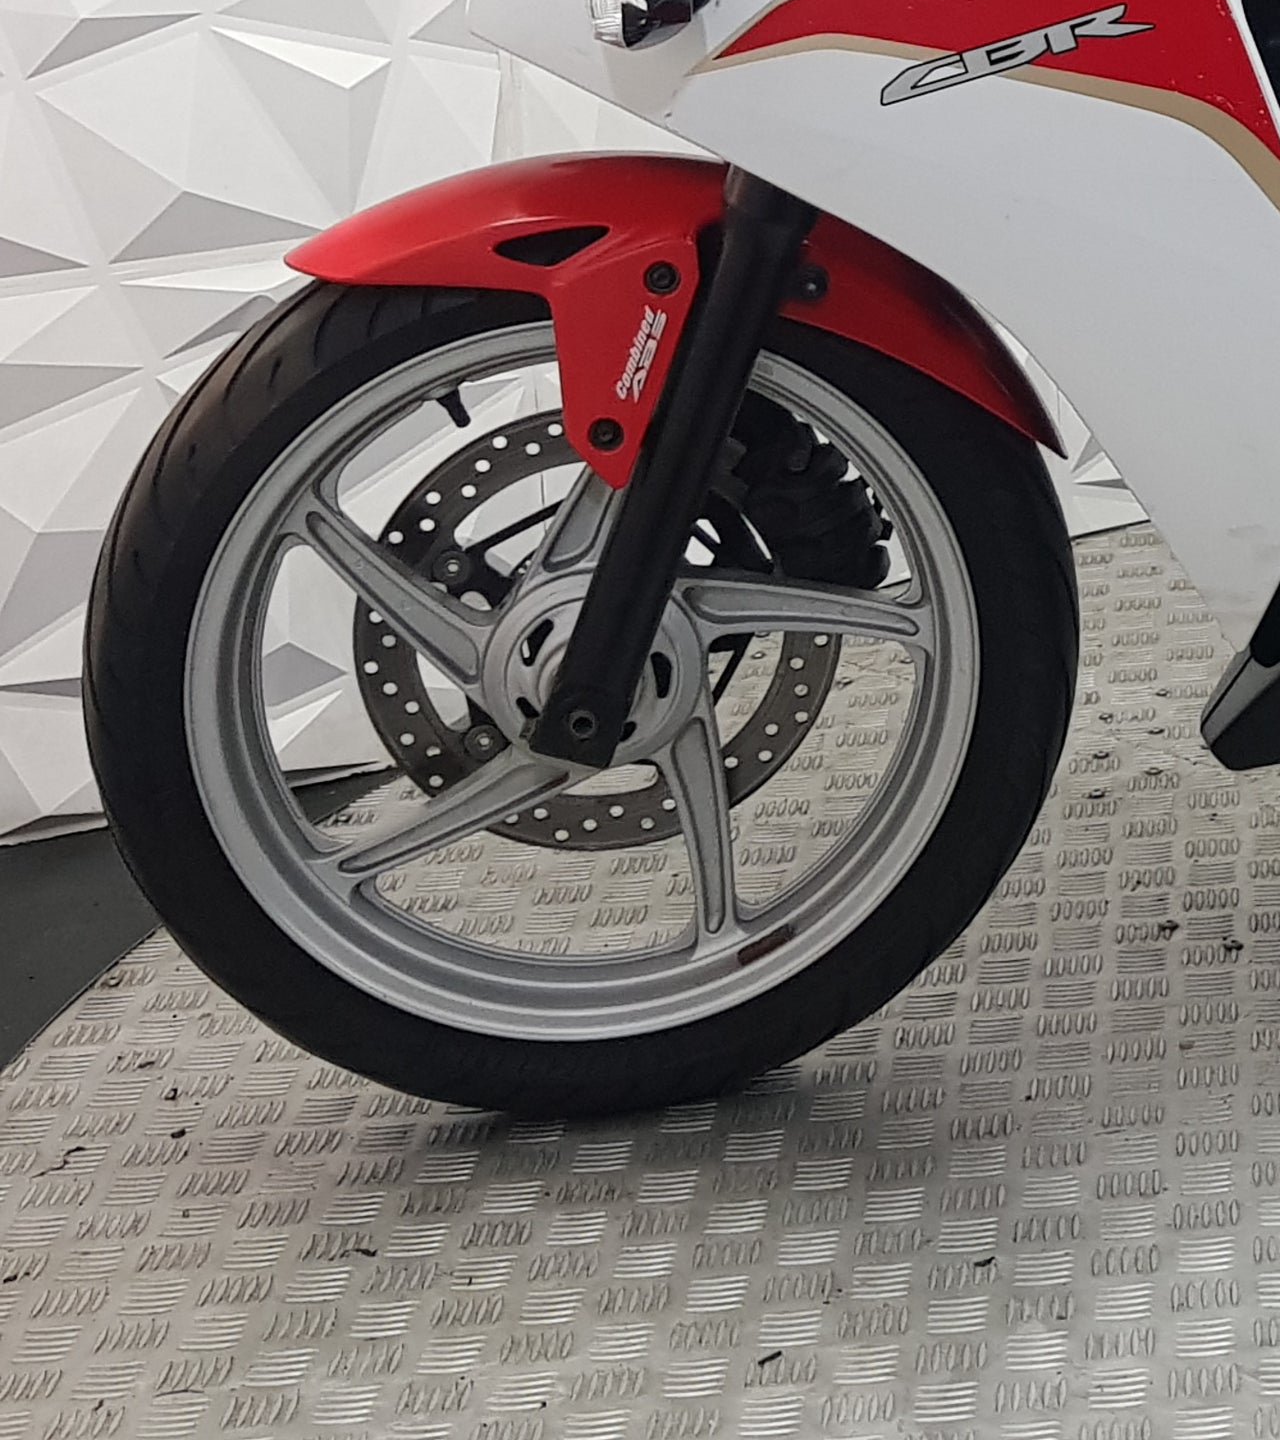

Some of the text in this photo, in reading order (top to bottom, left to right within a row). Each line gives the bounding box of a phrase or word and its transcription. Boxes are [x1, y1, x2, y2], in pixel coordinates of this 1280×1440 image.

[880, 2, 1155, 106] CBR
[616, 305, 654, 400] Combined
[632, 309, 667, 403] ABS
